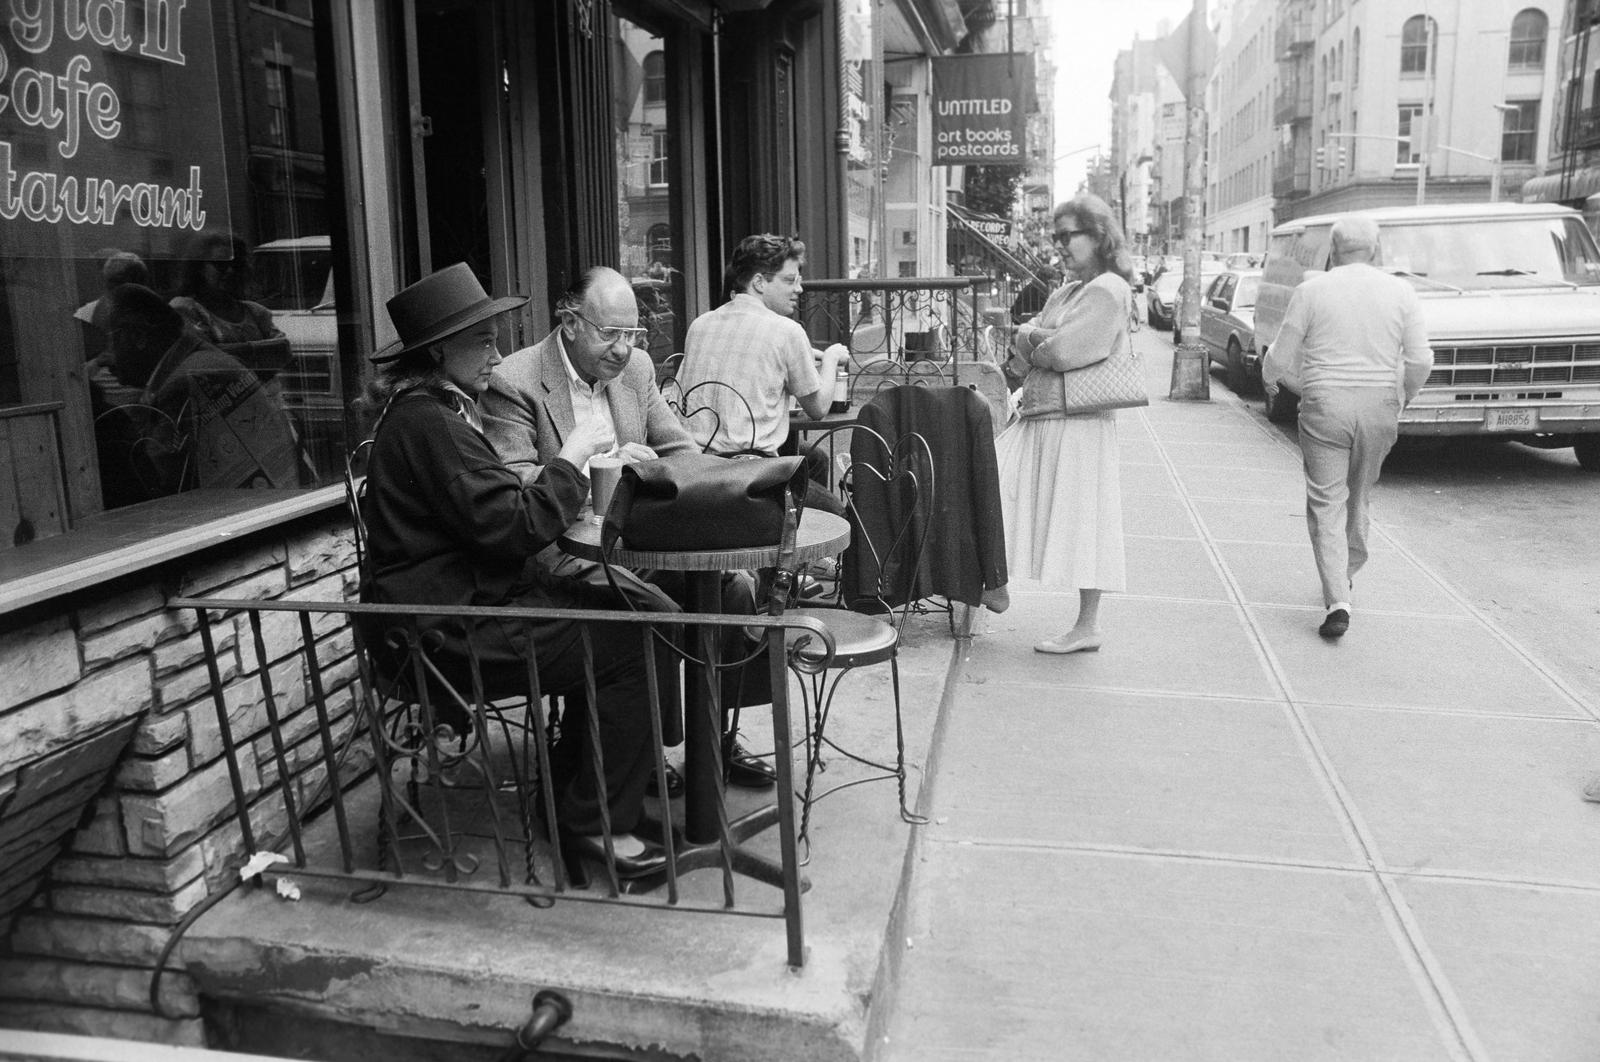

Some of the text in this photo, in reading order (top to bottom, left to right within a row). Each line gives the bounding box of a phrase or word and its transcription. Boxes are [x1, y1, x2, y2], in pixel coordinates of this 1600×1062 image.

[938, 98, 1012, 116] UNTITLED
[938, 127, 1012, 142] art books
[938, 142, 1019, 159] postcards
